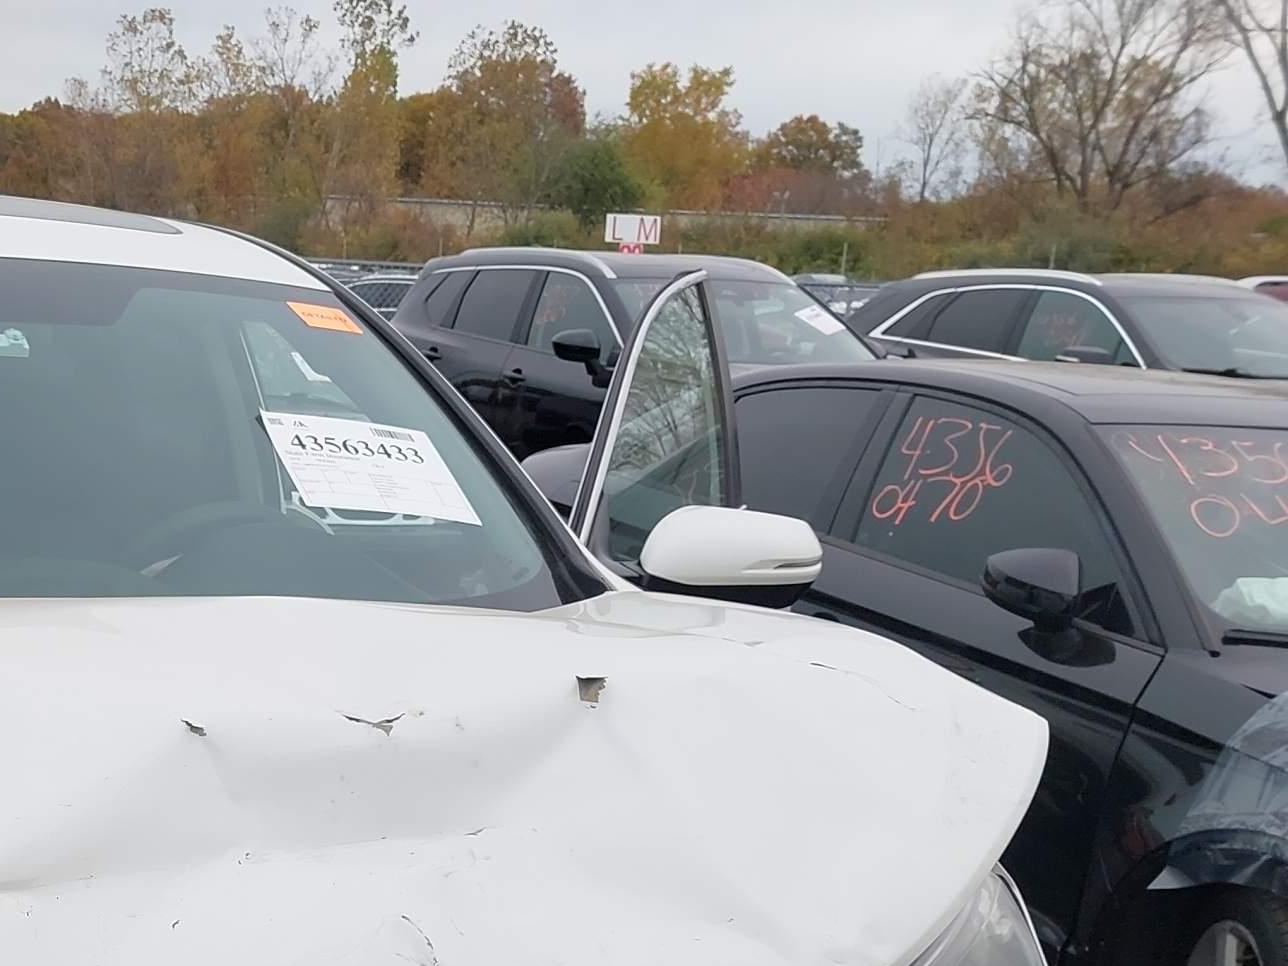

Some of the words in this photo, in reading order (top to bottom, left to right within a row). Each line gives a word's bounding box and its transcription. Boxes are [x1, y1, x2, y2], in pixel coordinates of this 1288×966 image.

[612, 215, 623, 240] L
[637, 216, 658, 242] M
[290, 434, 425, 465] 43563433
[901, 416, 1013, 486] 4356
[872, 476, 985, 525] 0470
